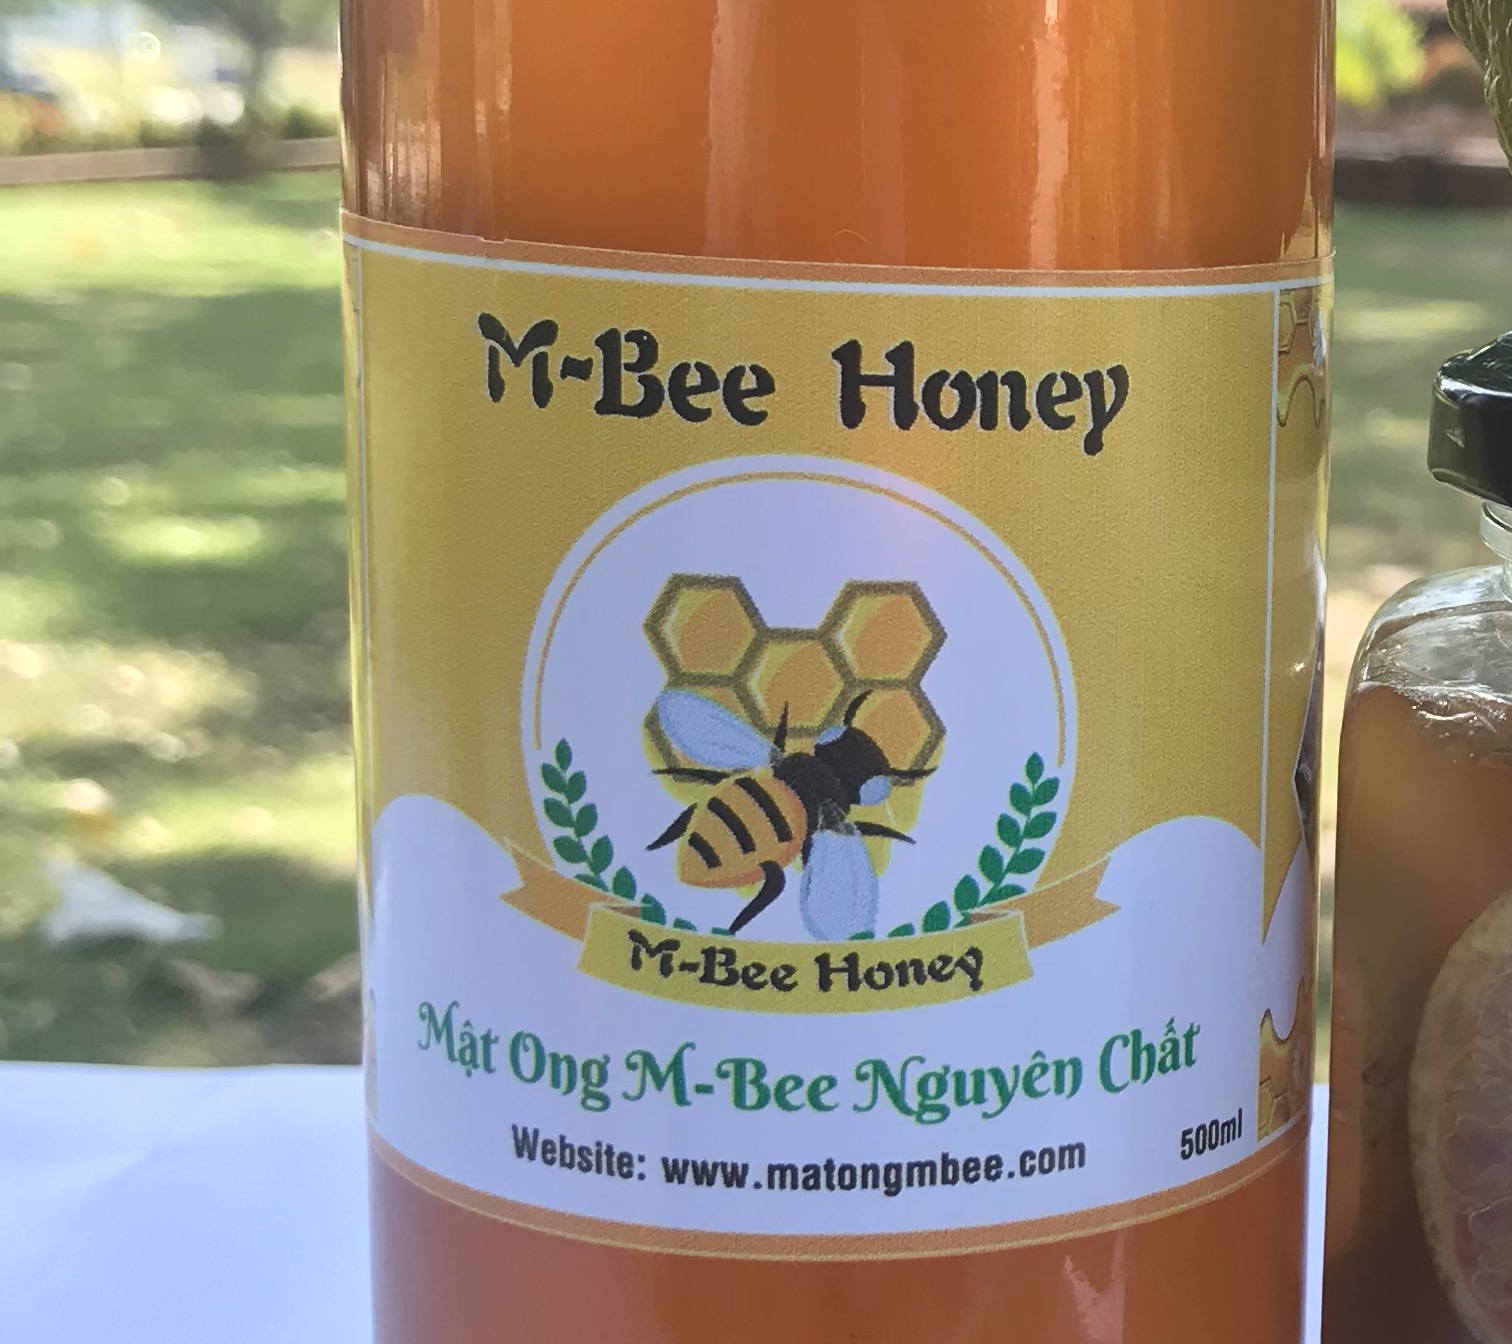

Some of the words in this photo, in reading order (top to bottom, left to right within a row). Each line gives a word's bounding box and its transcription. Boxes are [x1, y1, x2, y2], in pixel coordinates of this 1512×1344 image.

[477, 311, 776, 427] M-Bee
[830, 338, 1131, 456] Honey
[627, 928, 799, 993] M-Bee
[814, 946, 984, 993] Honey
[417, 999, 500, 1078] Mật
[508, 1029, 612, 1113] Ong
[621, 1041, 839, 1113] M-Bee
[852, 1049, 1083, 1125] Nguyên
[1099, 1016, 1201, 1094] Chất
[511, 1123, 647, 1182] Website:
[661, 1141, 1086, 1198] www.matongmbee.com
[1180, 1107, 1243, 1161] 500ml
